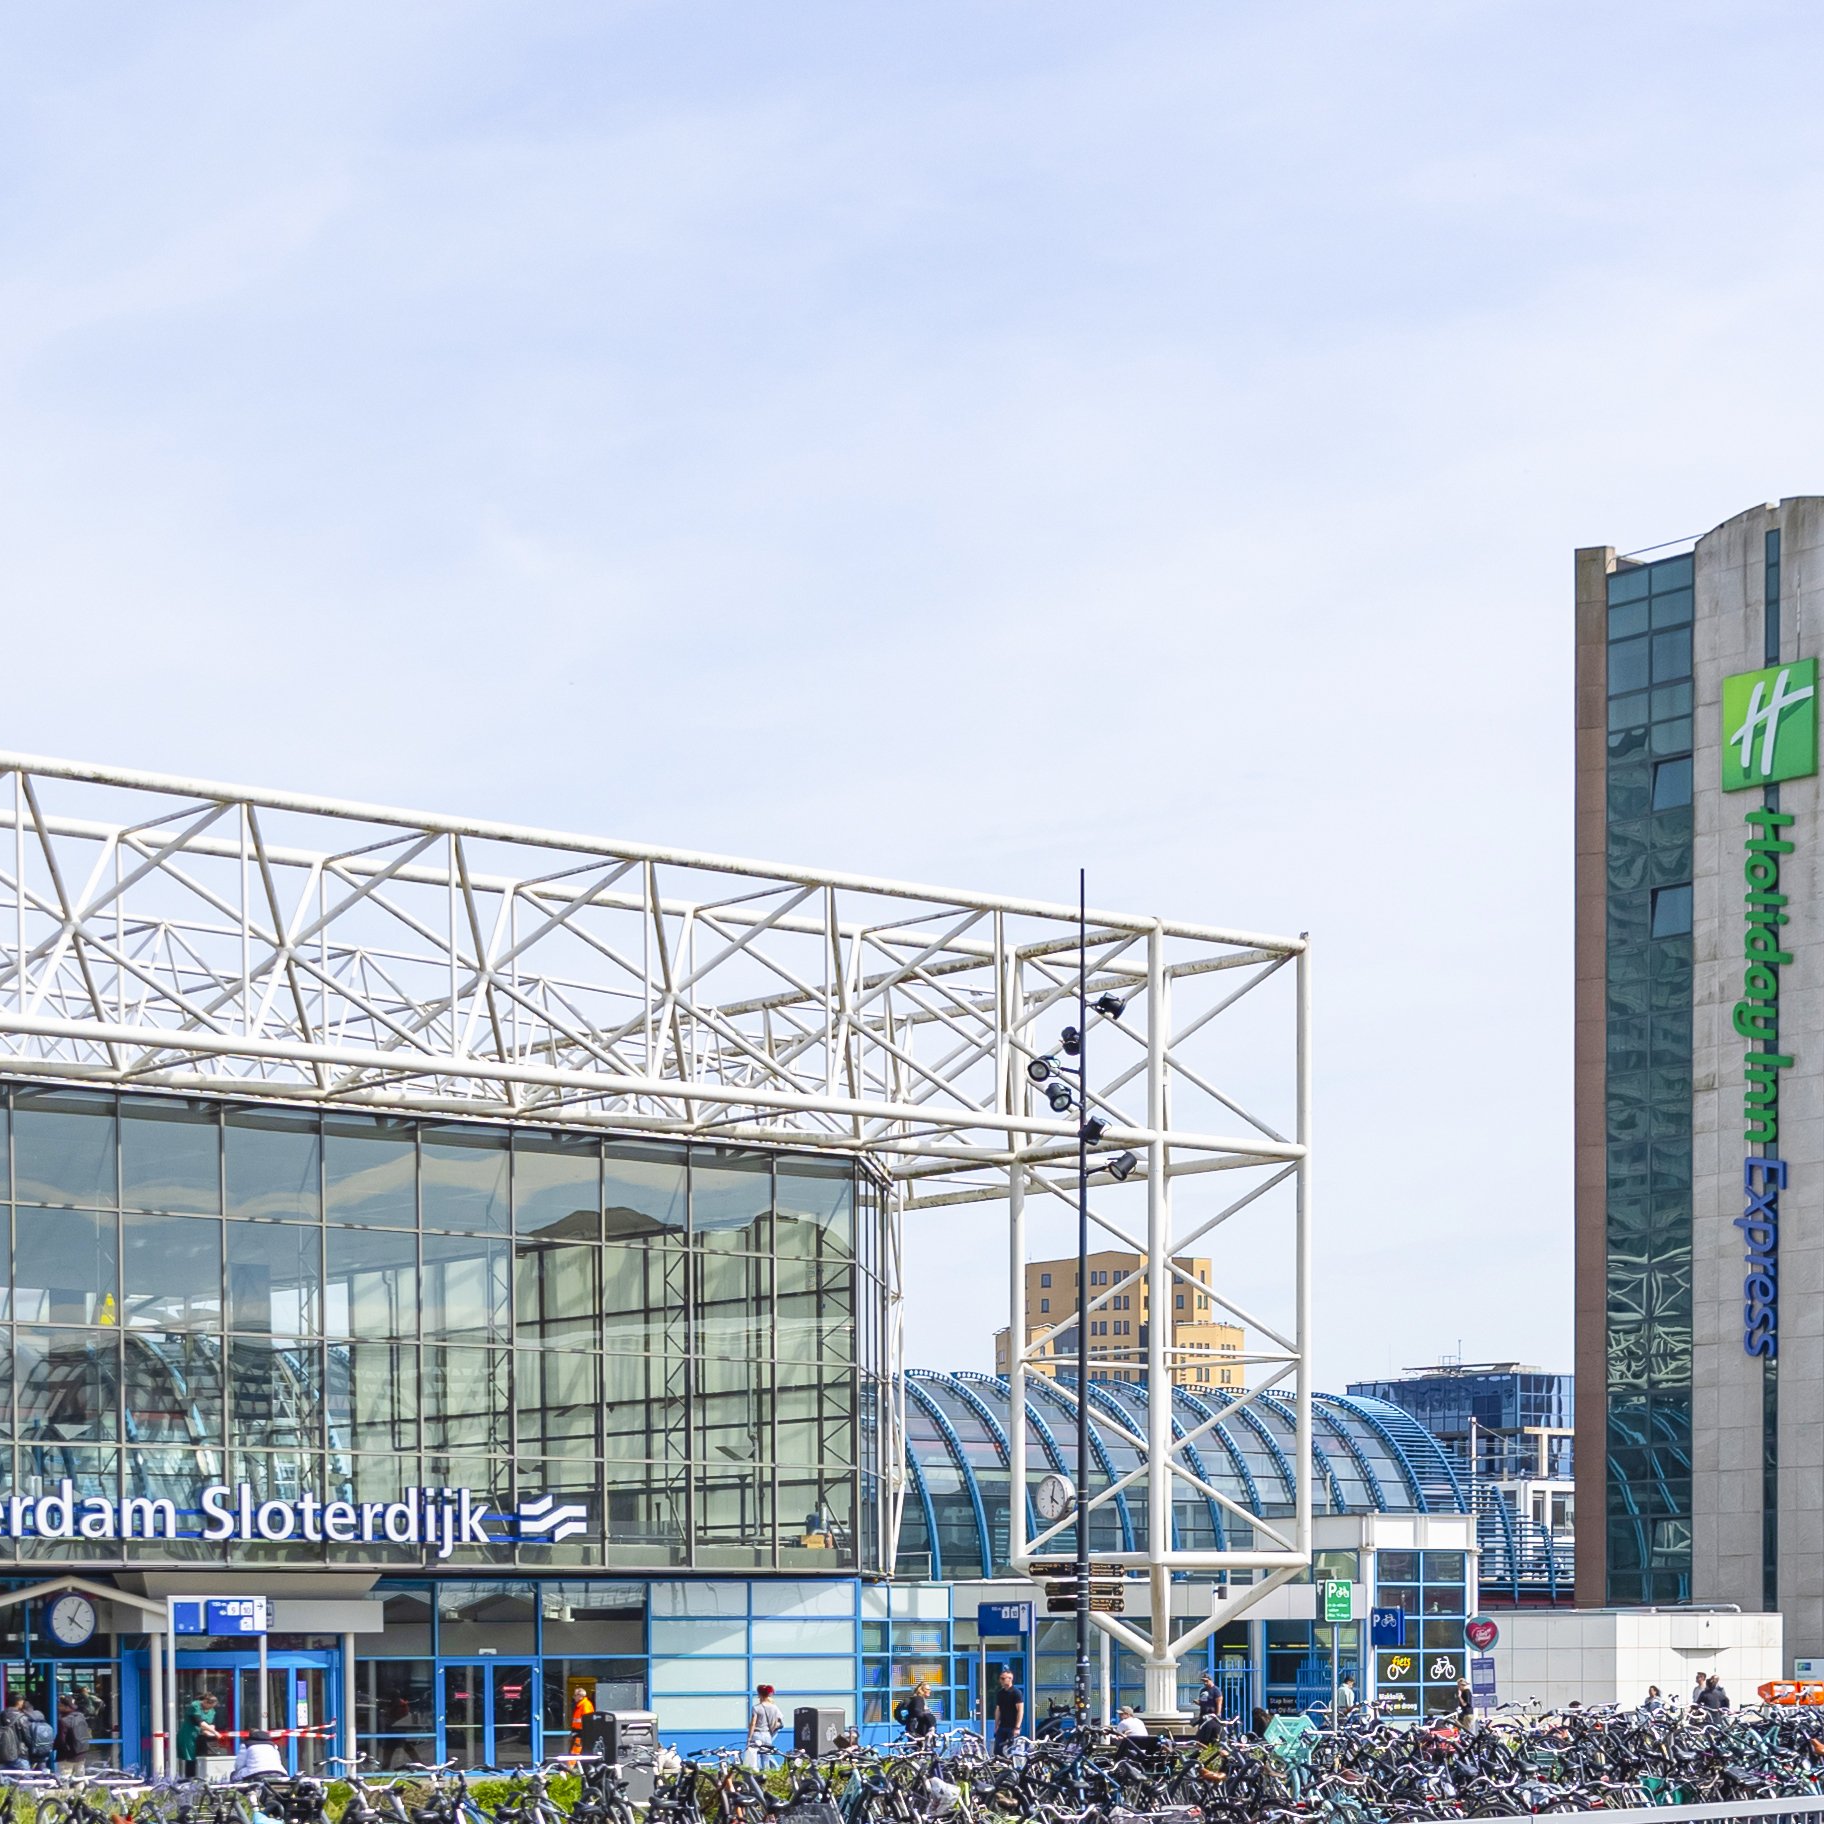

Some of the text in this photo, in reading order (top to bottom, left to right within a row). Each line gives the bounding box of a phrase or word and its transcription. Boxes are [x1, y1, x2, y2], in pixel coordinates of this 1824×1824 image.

[1733, 806, 1795, 1359] Holiday Inn Express
[201, 1482, 490, 1559] Sloterdijk
[1328, 1583, 1337, 1598] P
[1373, 1614, 1380, 1627] P
[1391, 1655, 1412, 1671] fiets
